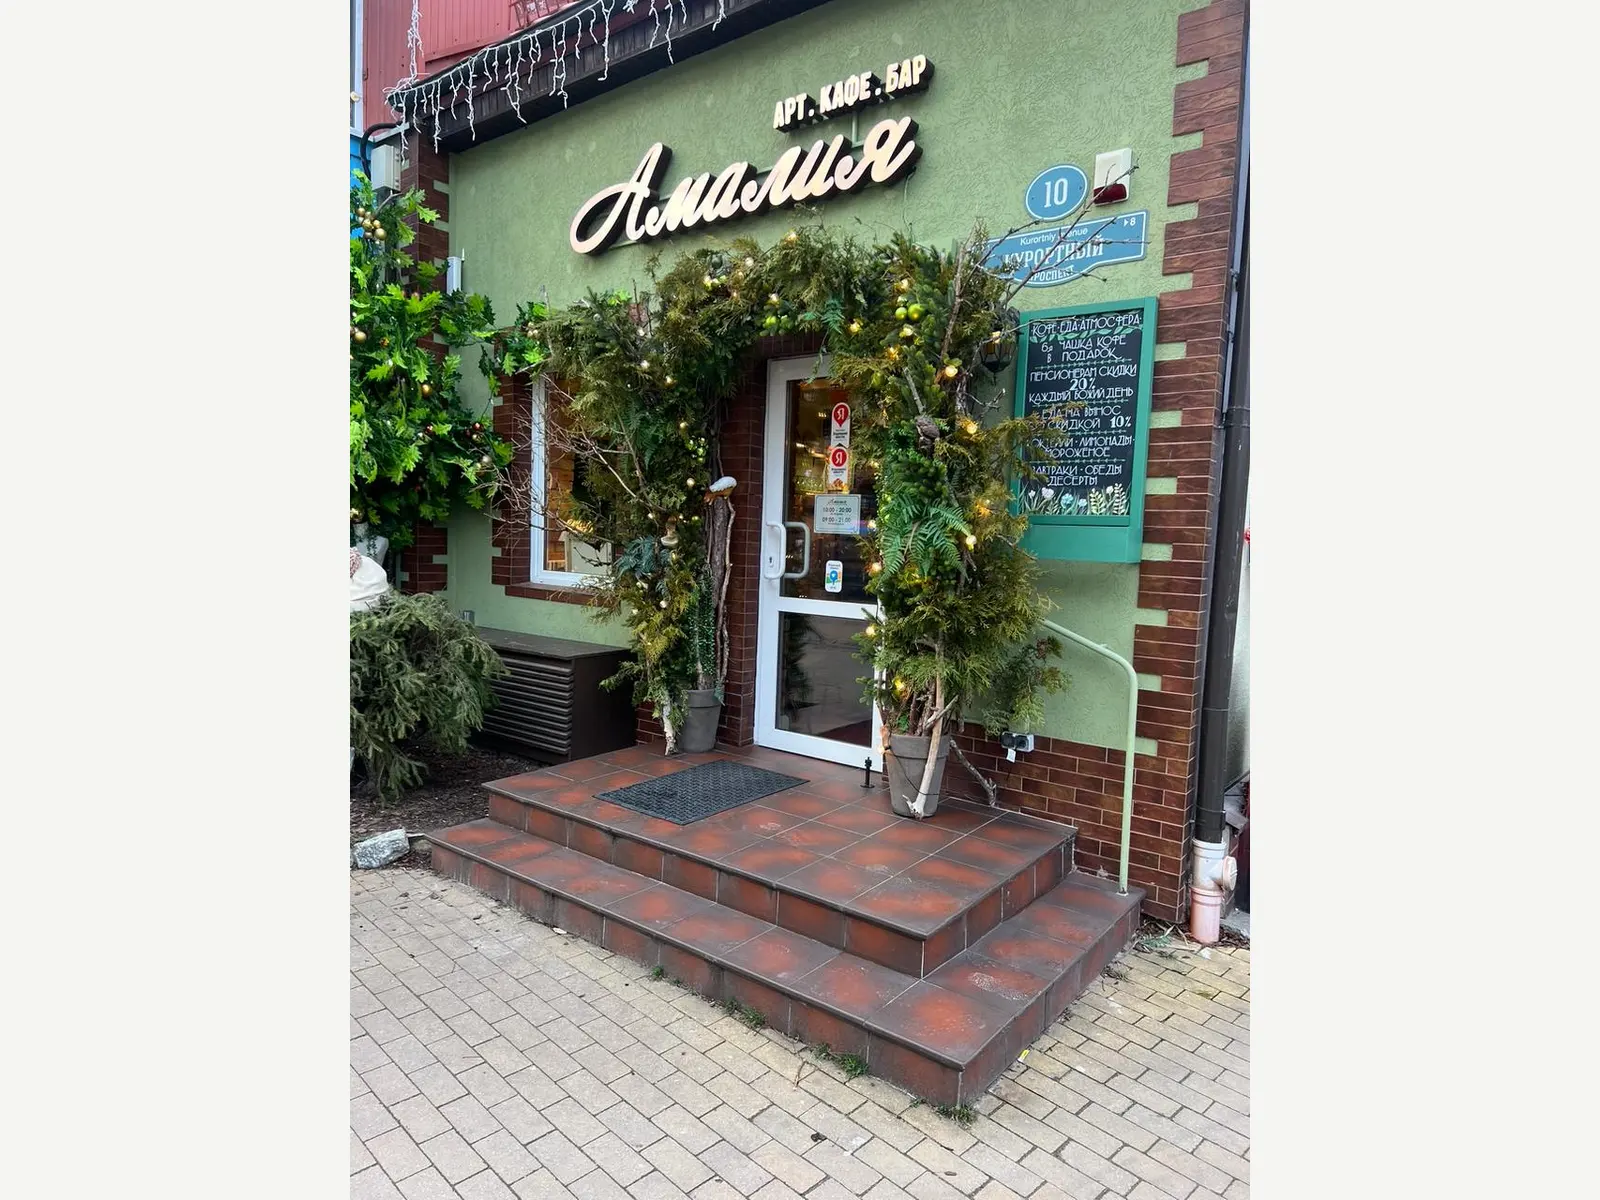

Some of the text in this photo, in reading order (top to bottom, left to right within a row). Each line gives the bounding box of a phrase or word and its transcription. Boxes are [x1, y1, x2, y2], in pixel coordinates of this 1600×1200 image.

[885, 53, 928, 95] БАР
[569, 116, 918, 254] Амалия
[1043, 178, 1068, 208] 10
[1129, 218, 1136, 226] 8
[1020, 233, 1056, 246] Kurortniy
[1004, 234, 1104, 268] КУРОРТНЫЙ
[1059, 338, 1093, 350] ЧАШКА
[1096, 334, 1127, 349] КОФЕ
[1046, 347, 1122, 363] В ПОДАРОК
[1030, 364, 1138, 382] ПЕНСИОНЕРАМ СКИДКИ
[1069, 378, 1096, 391] 20%
[1029, 387, 1134, 405] КАЖДЫЙ БОЖИЙ ДЕНЬ
[1084, 405, 1121, 417] ВЫНОС
[1047, 418, 1101, 432] СКИДКОЙ
[1109, 415, 1132, 429] 10%
[1079, 435, 1133, 447] ЛИМОНАДЫ
[1084, 464, 1122, 475] ОБЕДЫ
[1047, 475, 1098, 487] ДЕСЕРТЫ
